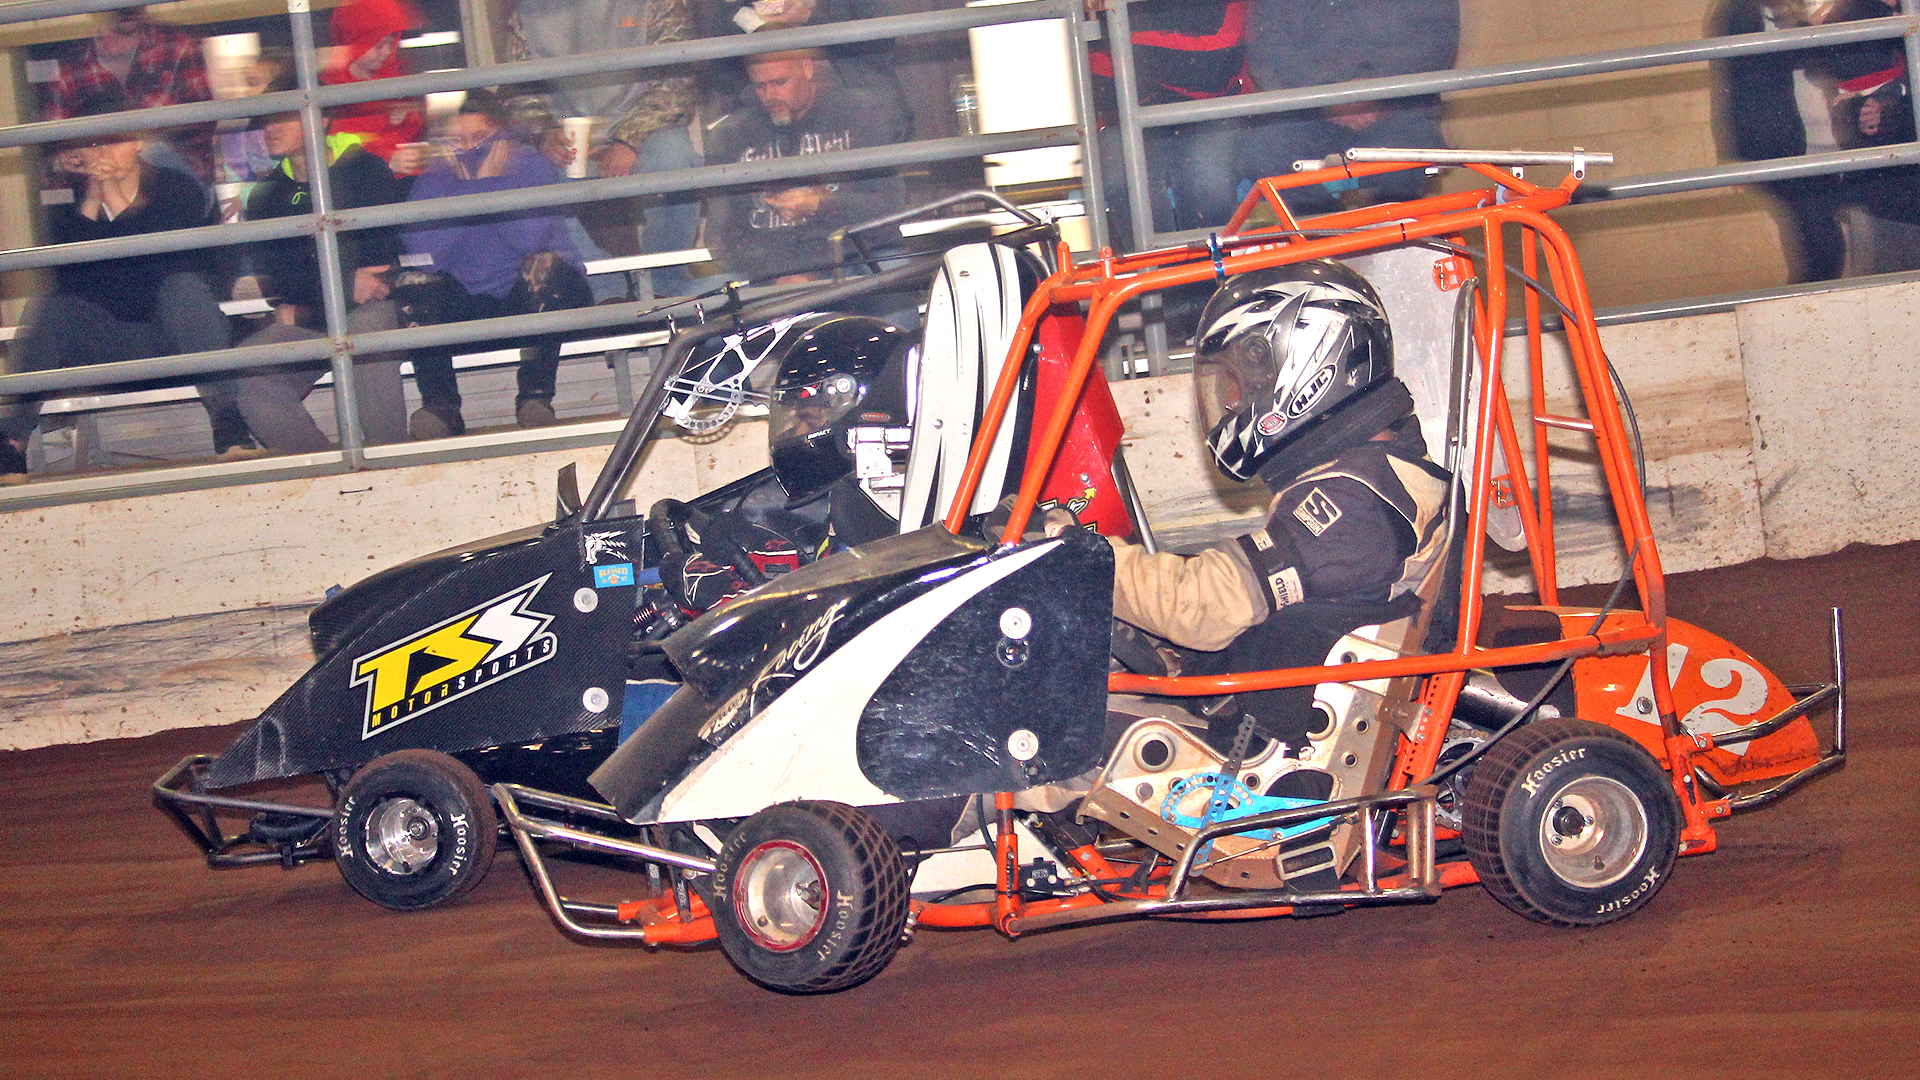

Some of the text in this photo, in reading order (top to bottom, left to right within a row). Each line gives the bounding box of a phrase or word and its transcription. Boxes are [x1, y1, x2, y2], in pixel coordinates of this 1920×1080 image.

[1294, 370, 1329, 412] HJC
[807, 428, 832, 441] IMPACT
[1296, 506, 1324, 535] SIMPSON
[1303, 491, 1338, 526] S
[598, 566, 629, 579] BLESSED
[371, 639, 551, 728] MOTORSPORTS
[750, 602, 846, 718] Racing
[1615, 642, 1768, 757] 12
[1520, 747, 1586, 799] Hoosier
[337, 796, 356, 858] Hoosier
[449, 813, 470, 876] Hoosier
[712, 831, 748, 902] Hoosier
[1596, 865, 1661, 914] Hoosier
[816, 889, 854, 961] Hoosier
